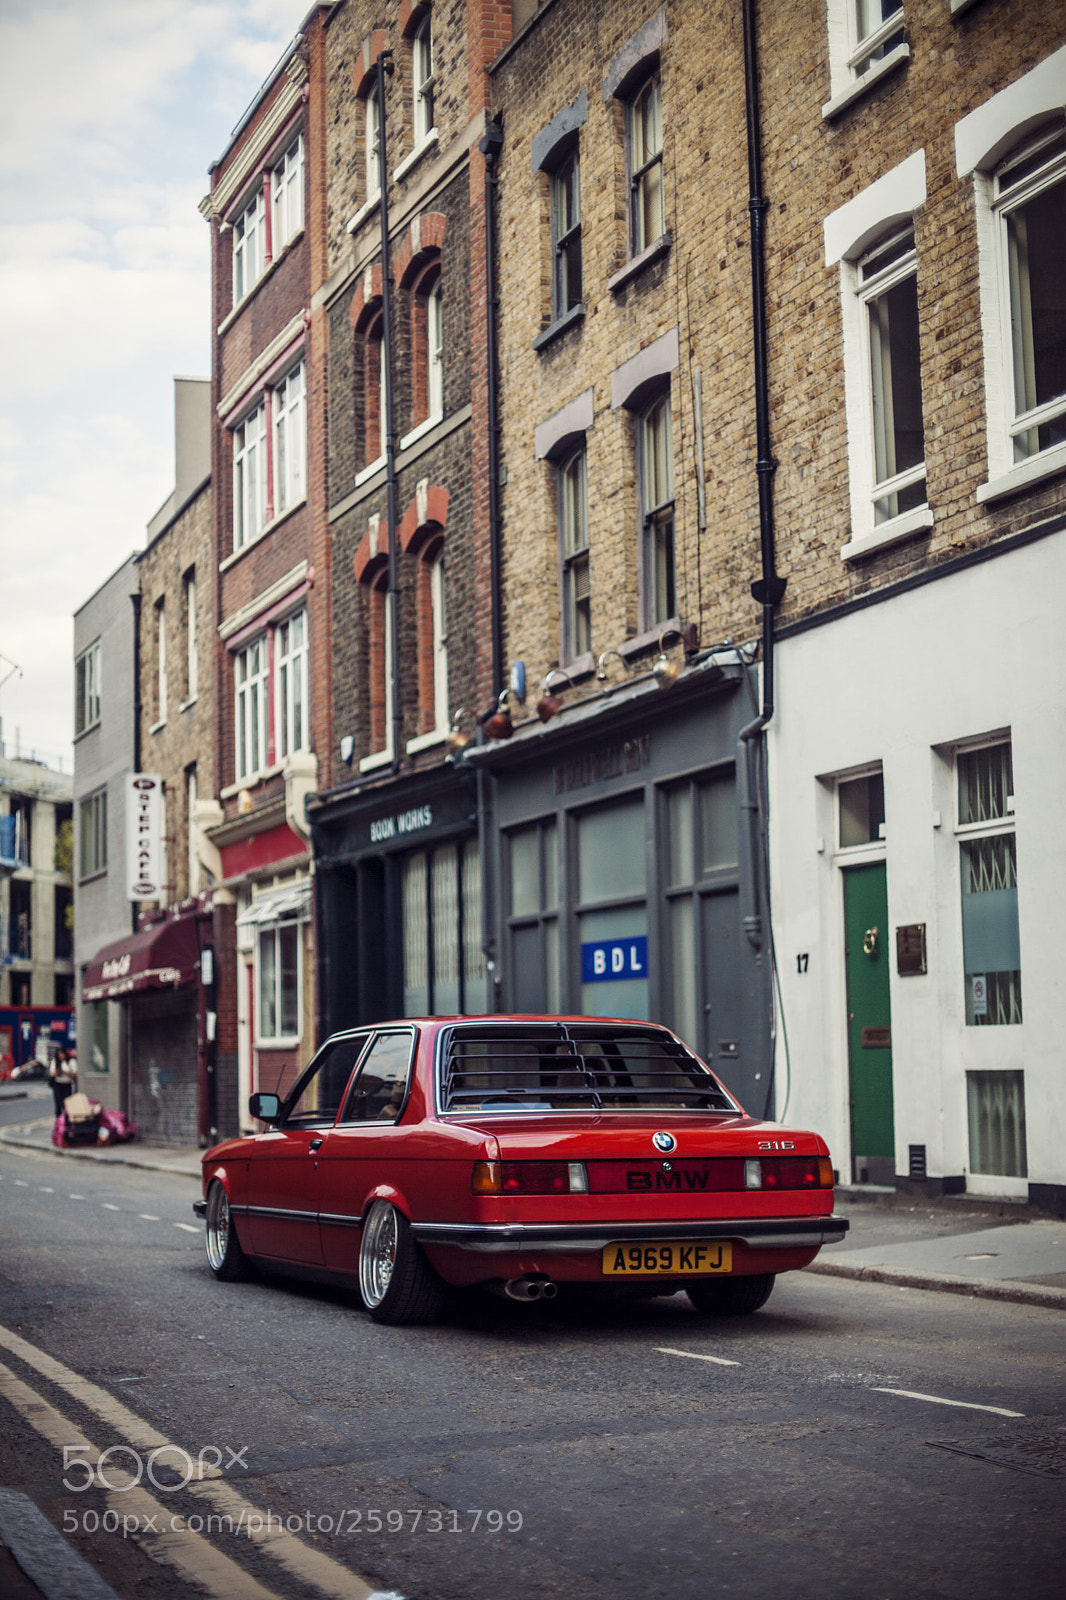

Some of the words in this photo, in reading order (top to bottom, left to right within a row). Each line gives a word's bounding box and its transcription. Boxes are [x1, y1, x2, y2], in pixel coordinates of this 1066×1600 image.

[370, 817, 396, 842] BOOK
[397, 804, 433, 834] WORKS
[796, 953, 809, 974] 17
[757, 1140, 796, 1150] 316
[626, 1169, 711, 1191] BMW
[613, 1246, 674, 1271] A969
[679, 1245, 724, 1270] KFJ
